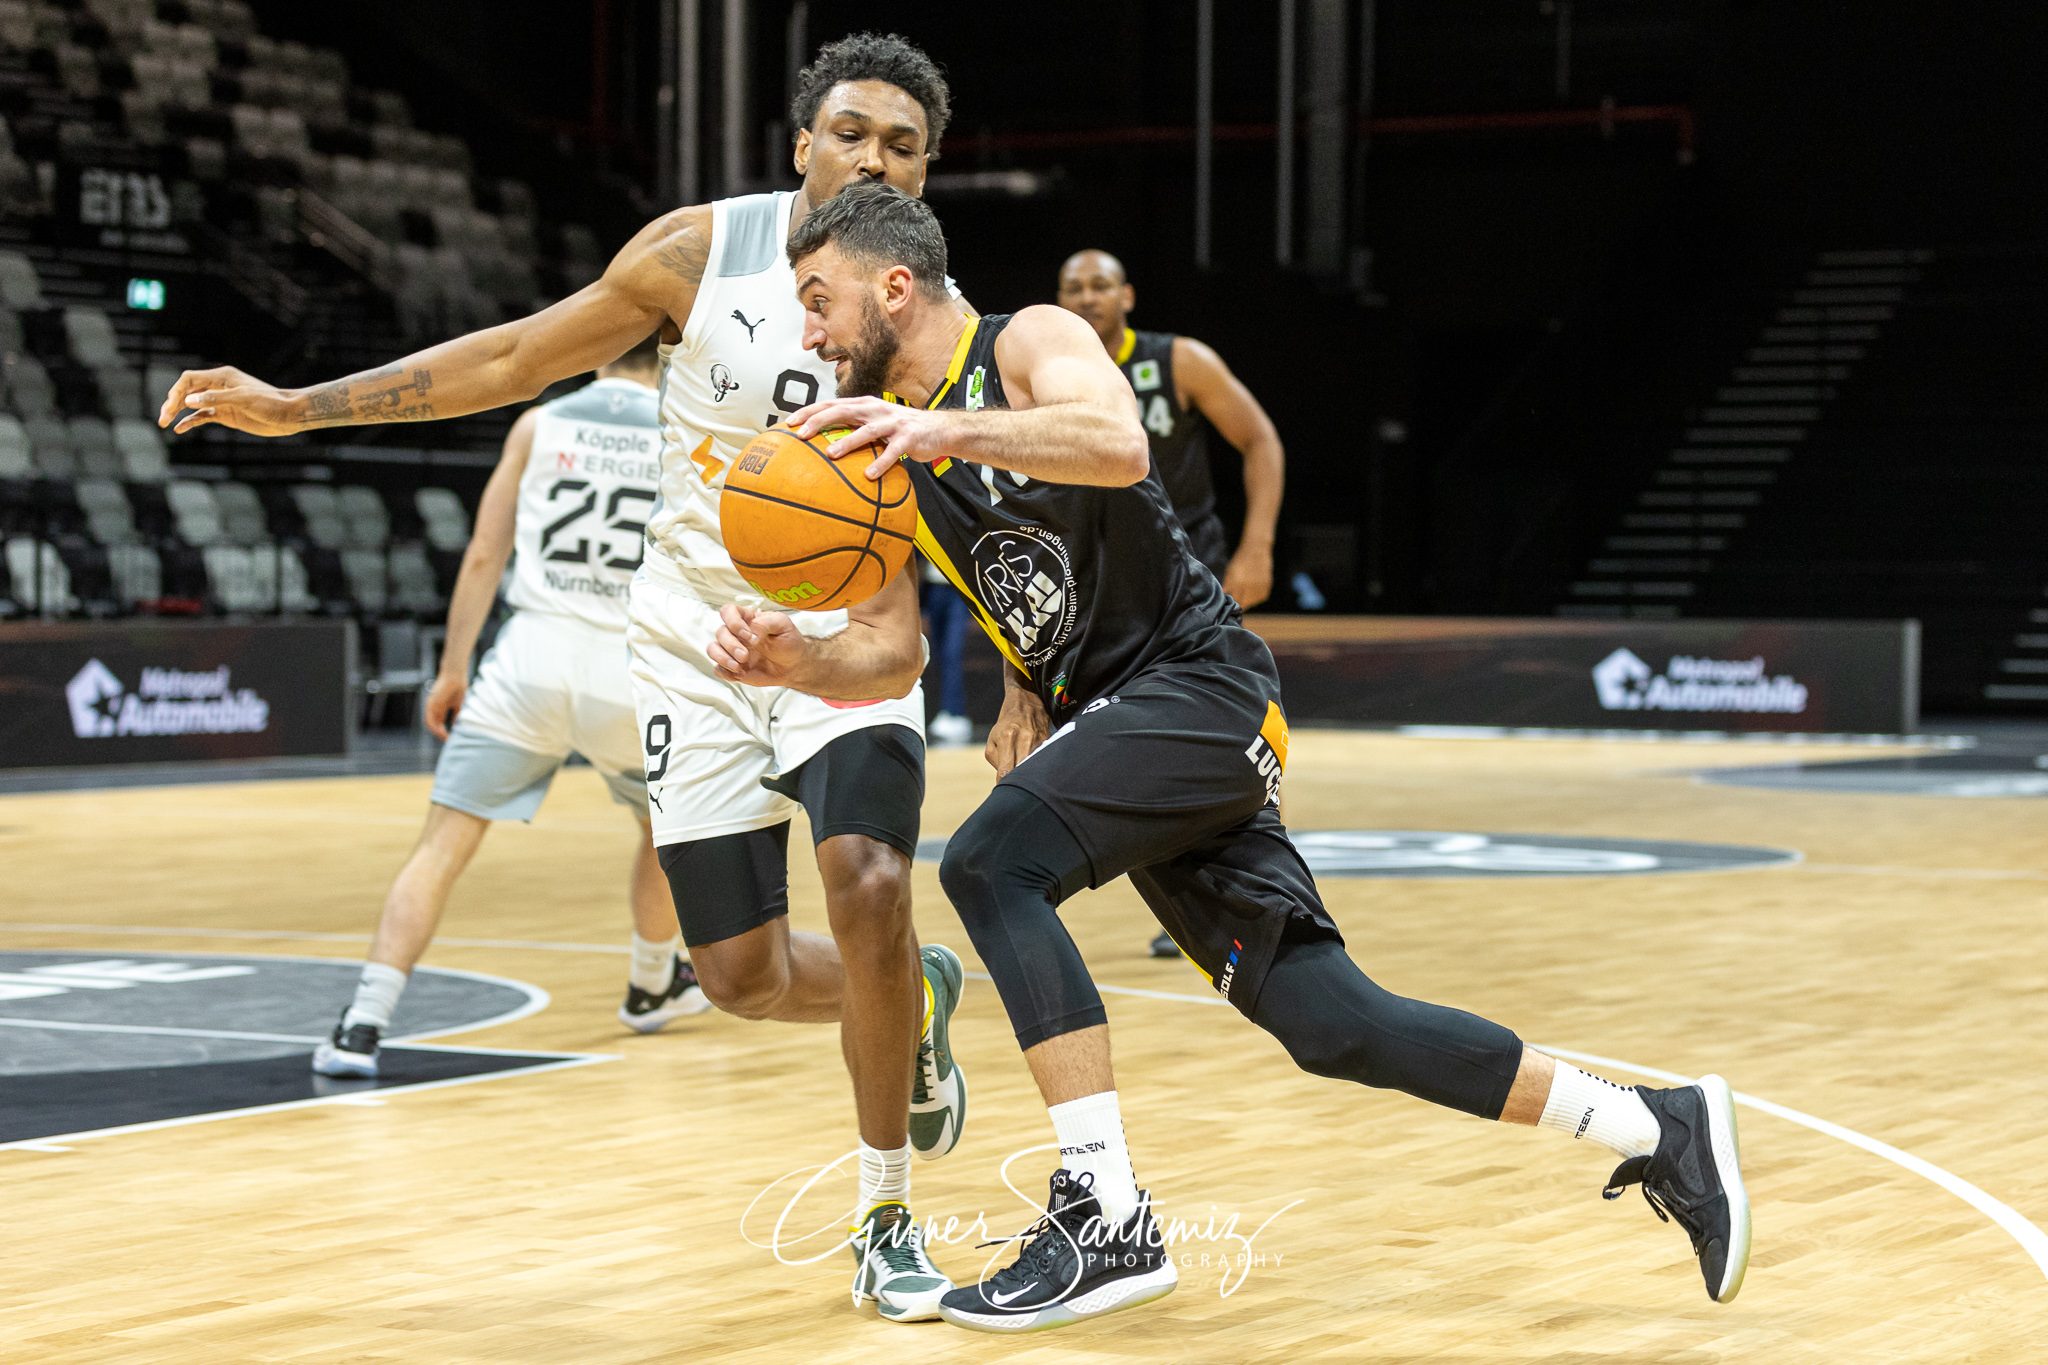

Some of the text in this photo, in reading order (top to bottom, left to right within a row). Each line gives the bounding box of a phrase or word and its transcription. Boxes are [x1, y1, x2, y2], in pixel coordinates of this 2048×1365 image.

[575, 426, 650, 454] Köpple
[738, 455, 769, 475] FIBA
[541, 479, 657, 571] 25
[116, 688, 270, 737] Automobile
[1645, 674, 1808, 714] Automobile
